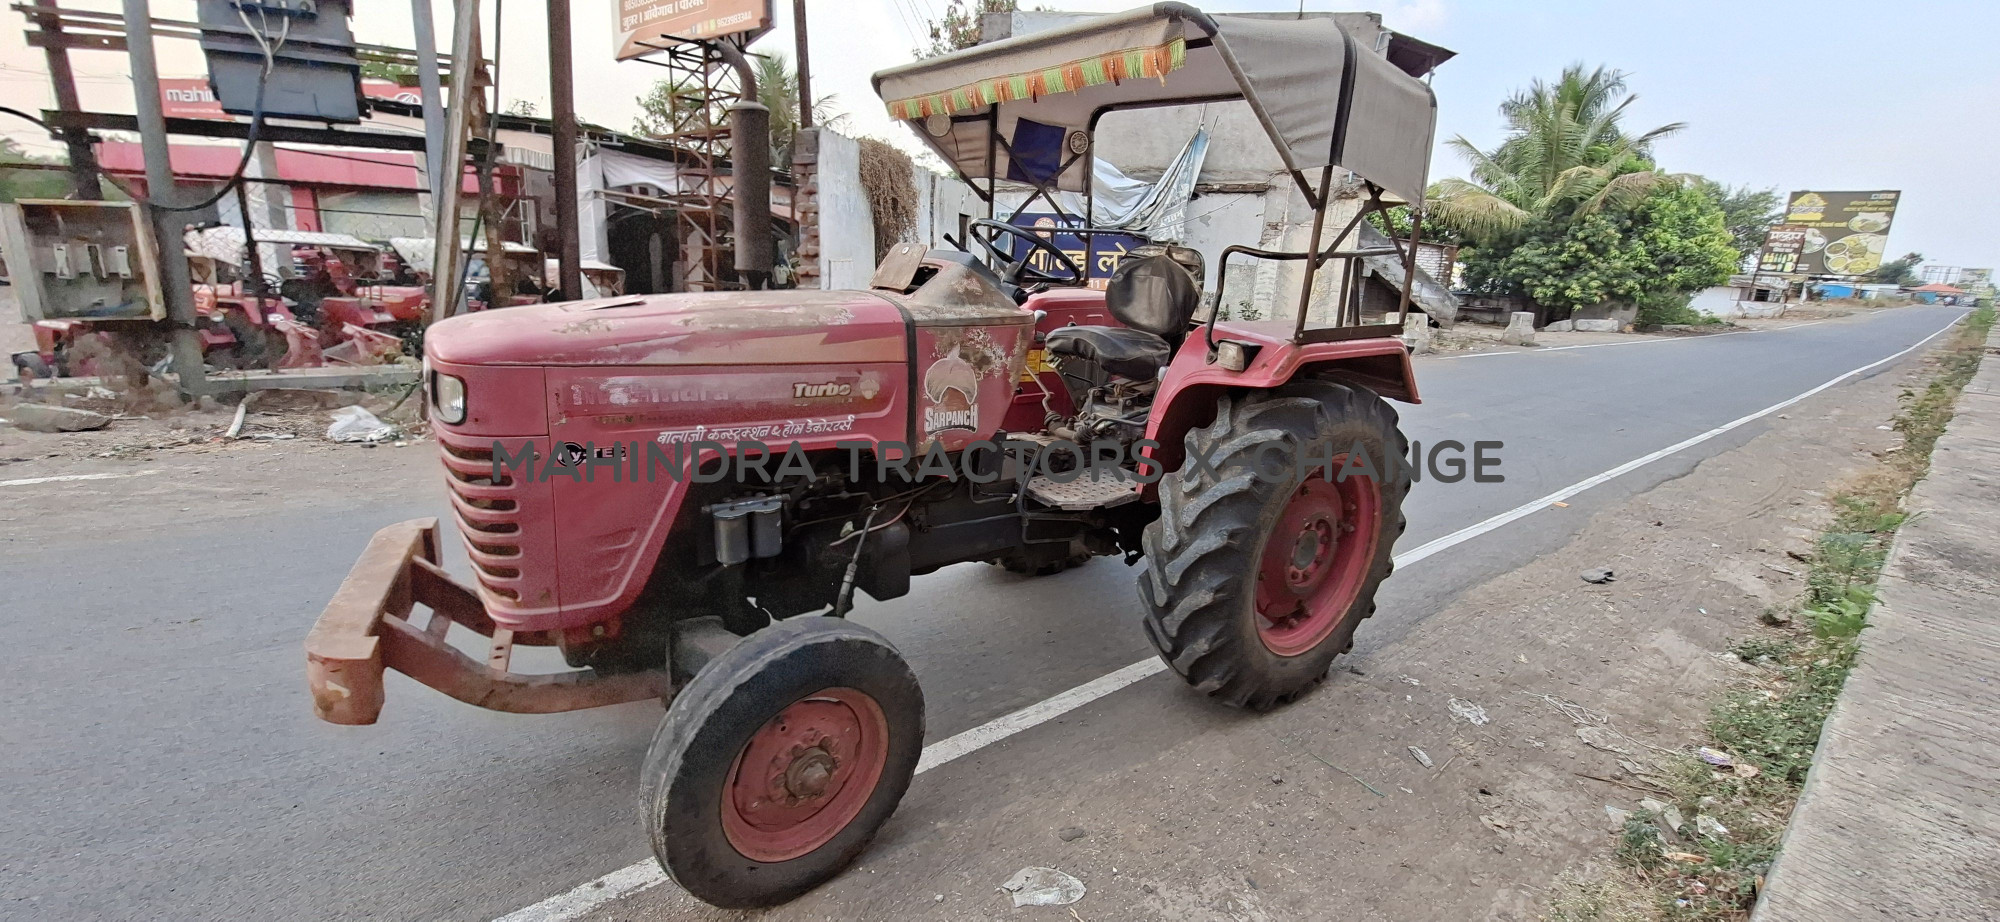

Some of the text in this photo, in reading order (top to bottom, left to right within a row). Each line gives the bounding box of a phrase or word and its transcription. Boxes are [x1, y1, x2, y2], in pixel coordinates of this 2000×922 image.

[793, 381, 852, 398] Turbo
[925, 403, 978, 432] SARPANCH
[657, 424, 708, 445] बालाजी
[771, 425, 781, 437] &
[782, 420, 803, 438] होम
